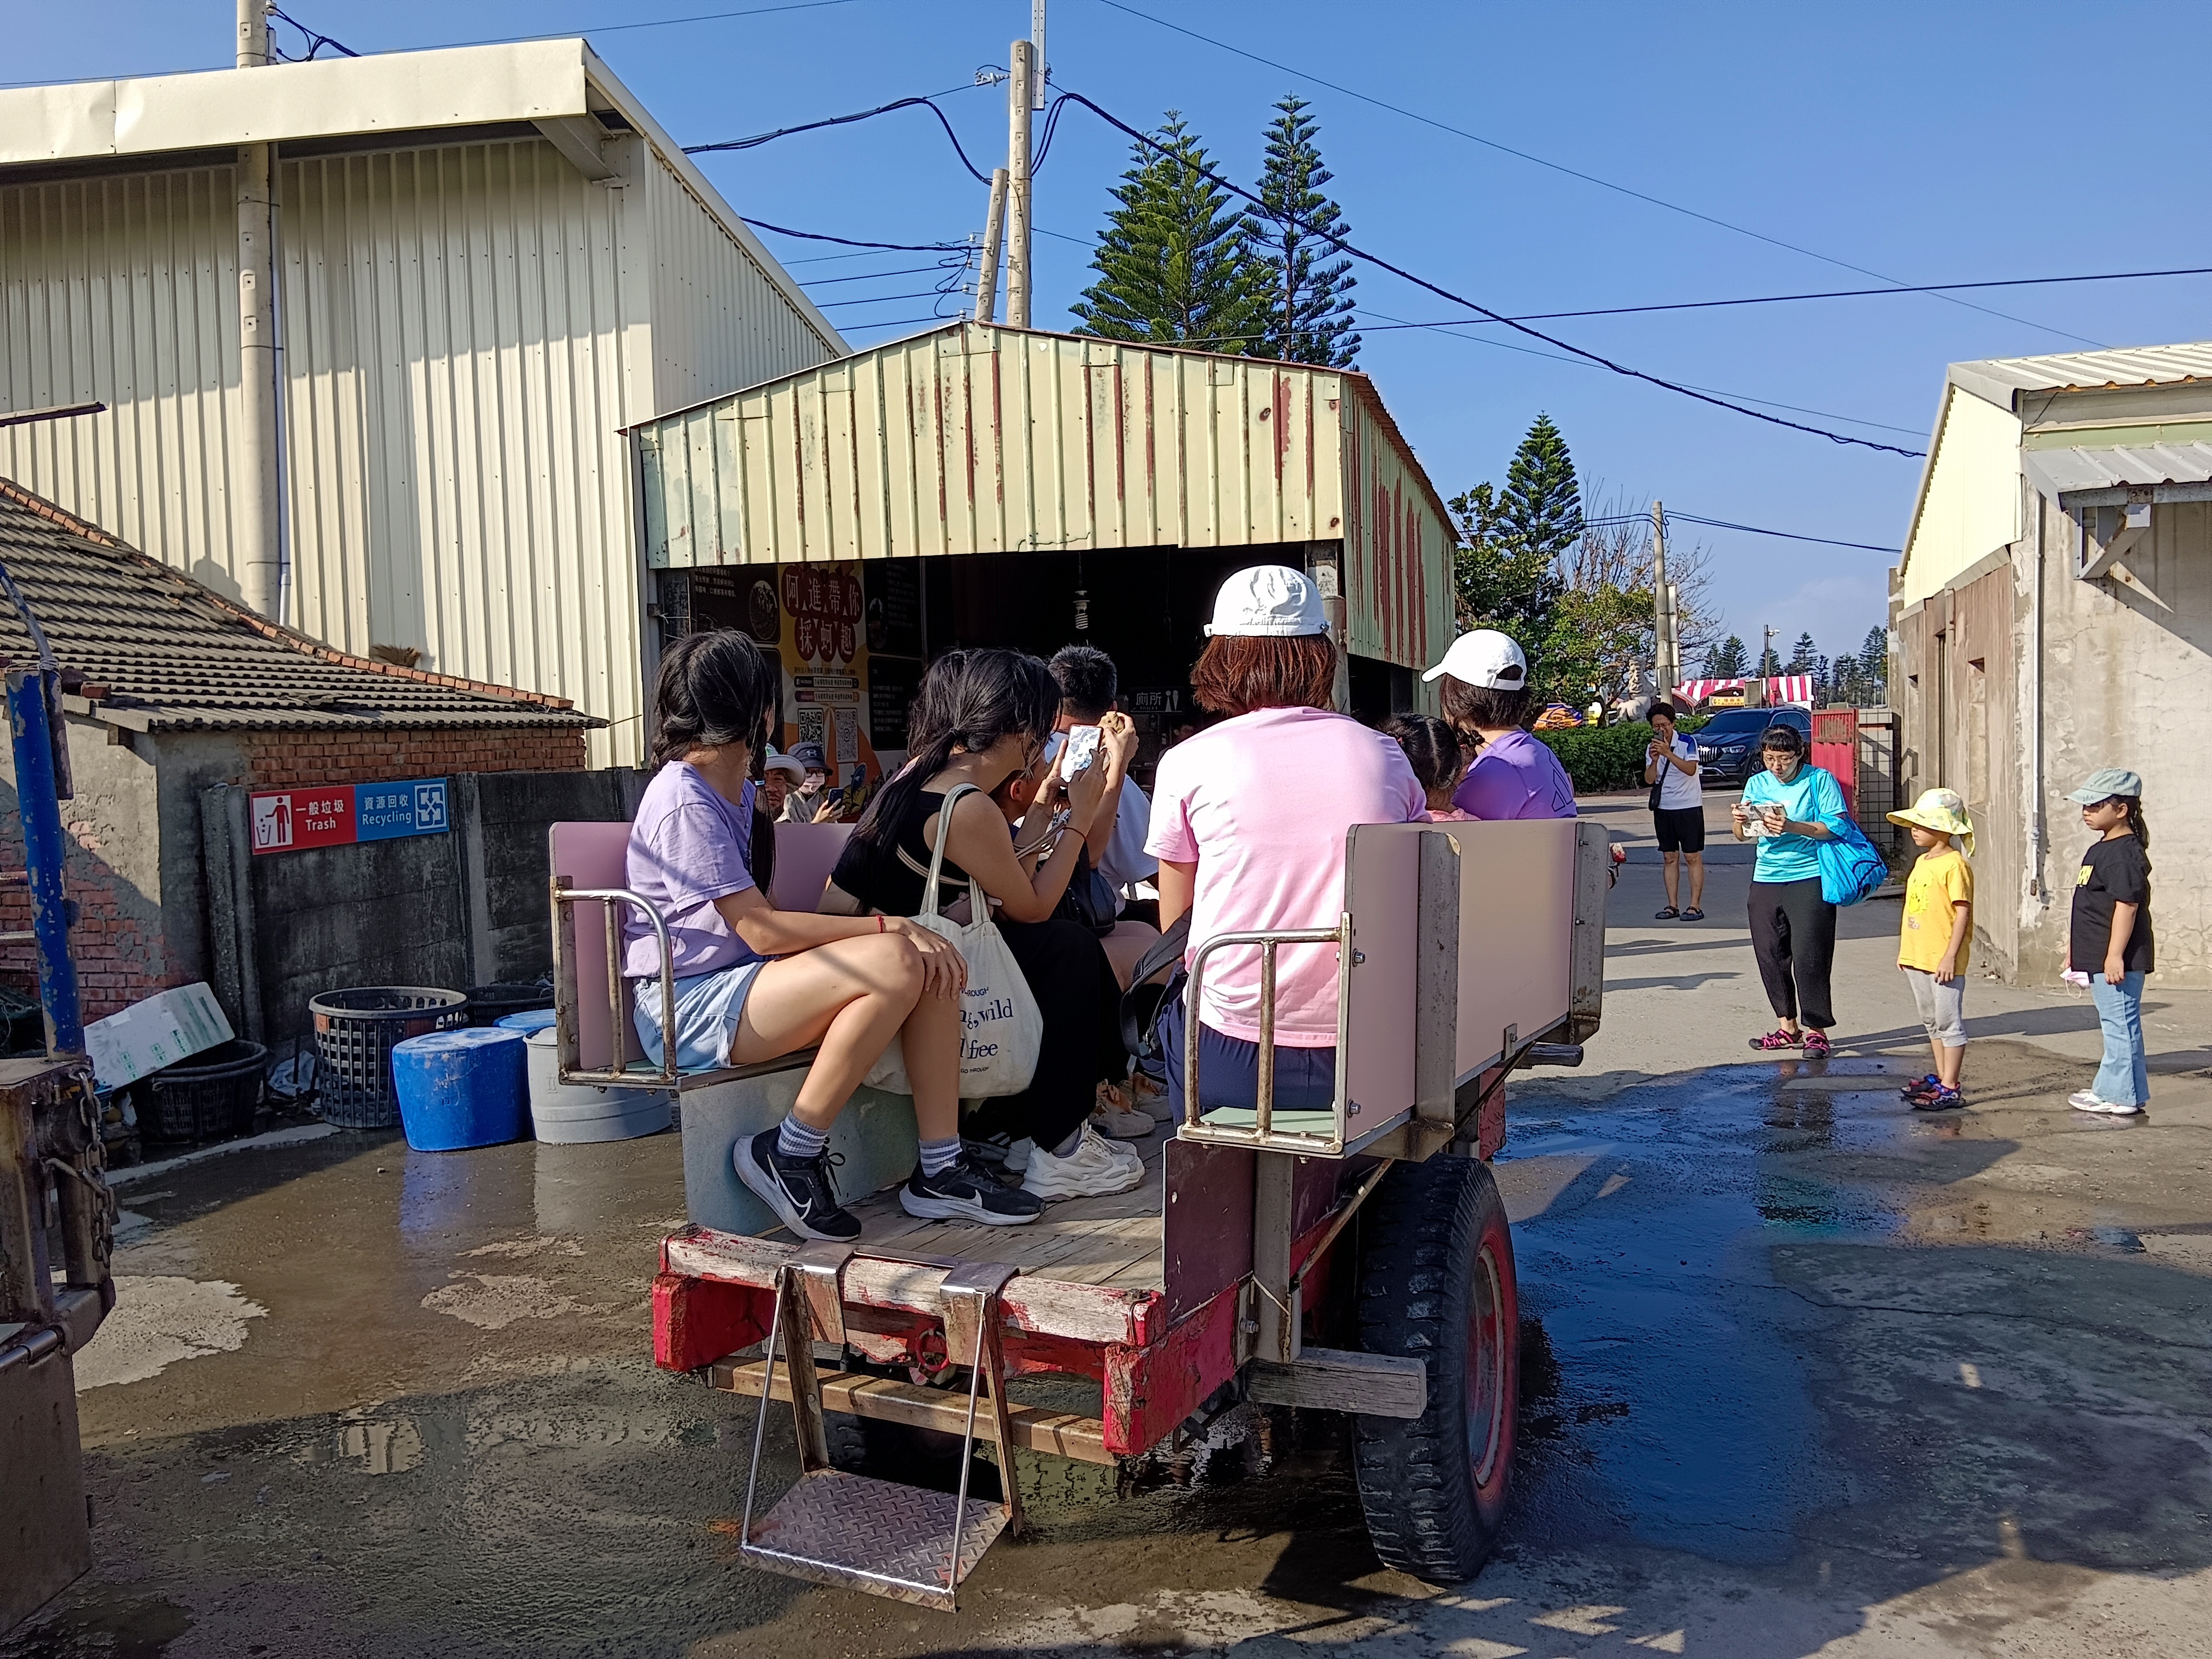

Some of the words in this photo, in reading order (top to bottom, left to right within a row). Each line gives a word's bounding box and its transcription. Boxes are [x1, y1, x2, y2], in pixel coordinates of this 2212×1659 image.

[786, 574, 859, 616] 阿進帶你
[799, 618, 852, 655] 採蚵趣
[1135, 691, 1162, 706] 廁所
[295, 799, 344, 815] 一般垃圾
[364, 794, 409, 811] 資源回收
[305, 817, 336, 831] Trash
[362, 811, 411, 827] Recycling
[978, 998, 1014, 1021] wild
